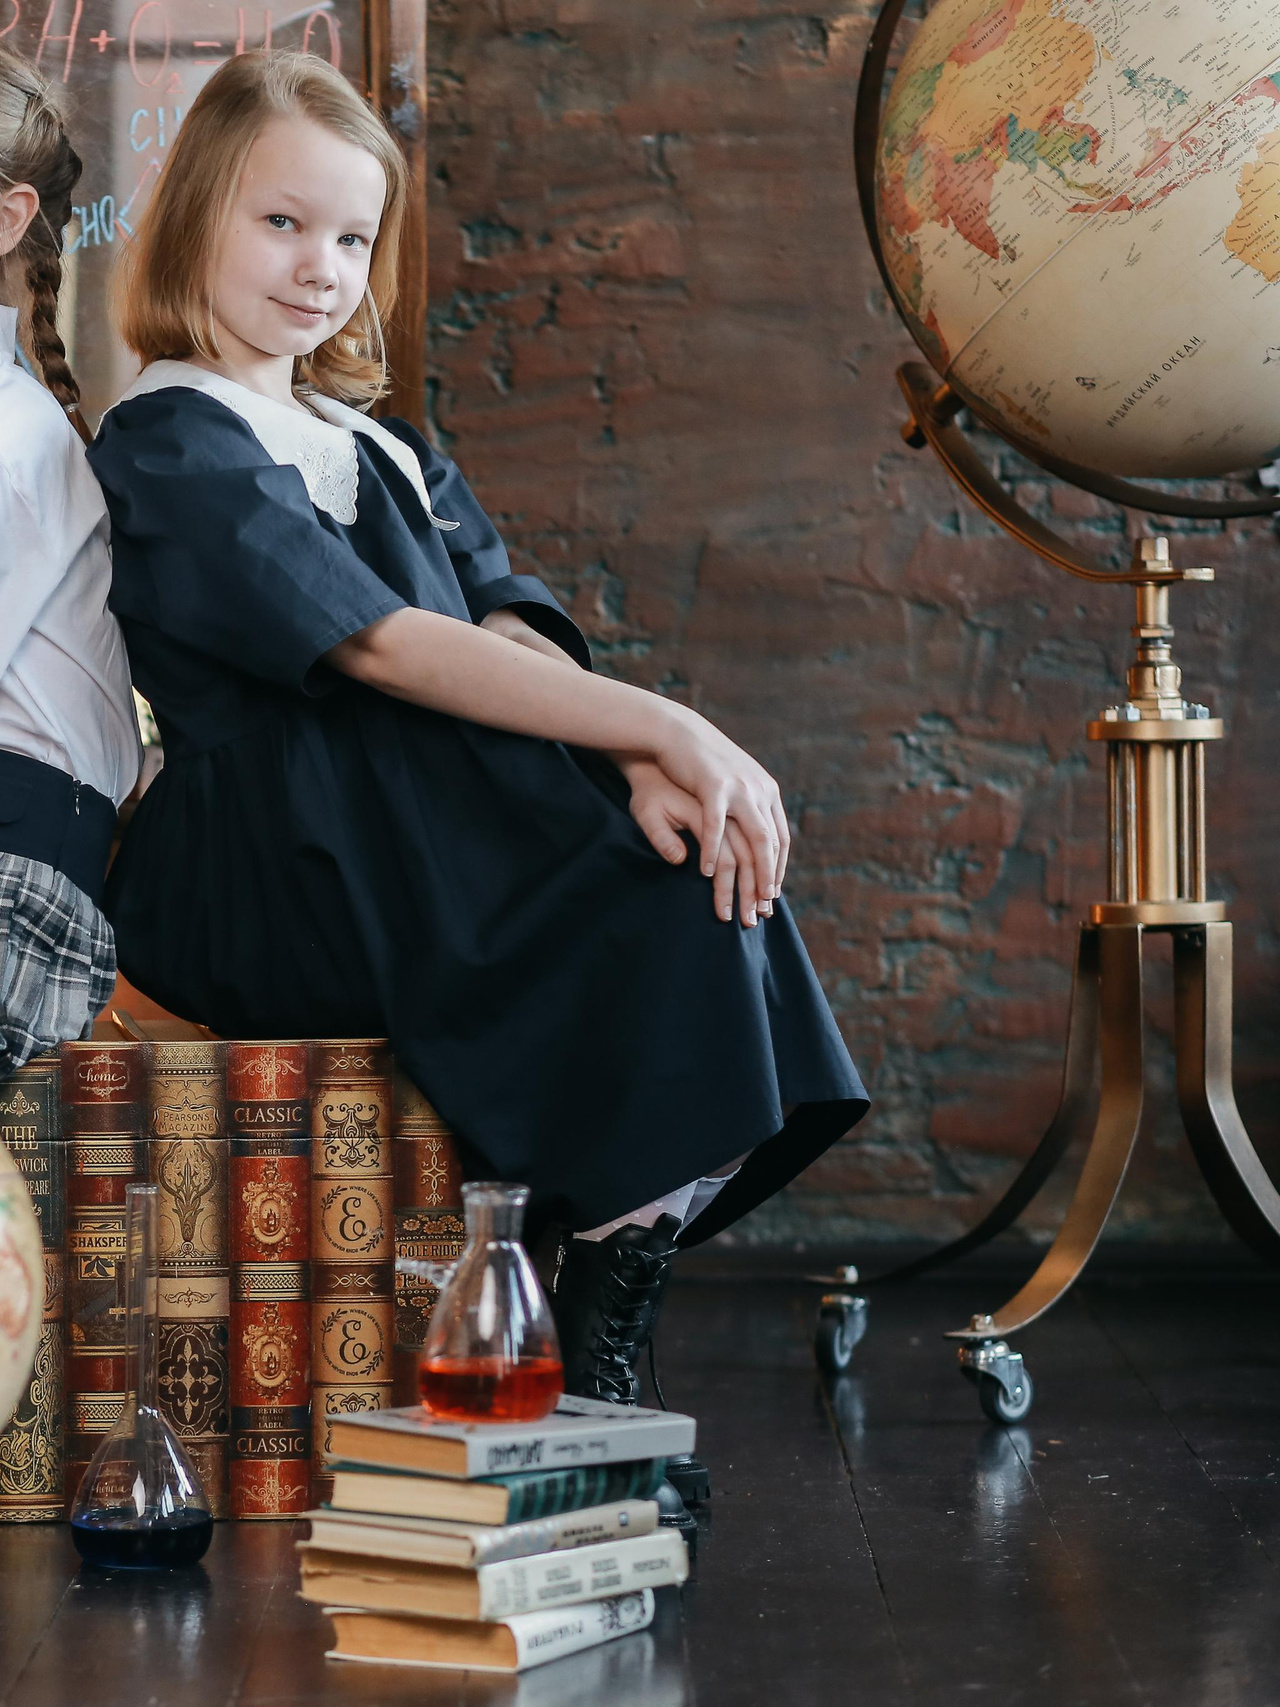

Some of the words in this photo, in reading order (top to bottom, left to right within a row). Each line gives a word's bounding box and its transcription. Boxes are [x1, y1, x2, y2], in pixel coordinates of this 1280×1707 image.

[971, 15, 1009, 50] МОНГОЛИЯ
[1105, 371, 1162, 428] ИНДИЙСКИЙ
[1161, 335, 1201, 373] ОКЕАН
[78, 1069, 126, 1083] home
[234, 1106, 303, 1124] CLASSIC
[158, 1123, 215, 1133] MAGAZINE
[1, 1125, 39, 1151] THE
[236, 1437, 305, 1453] CLASSIC
